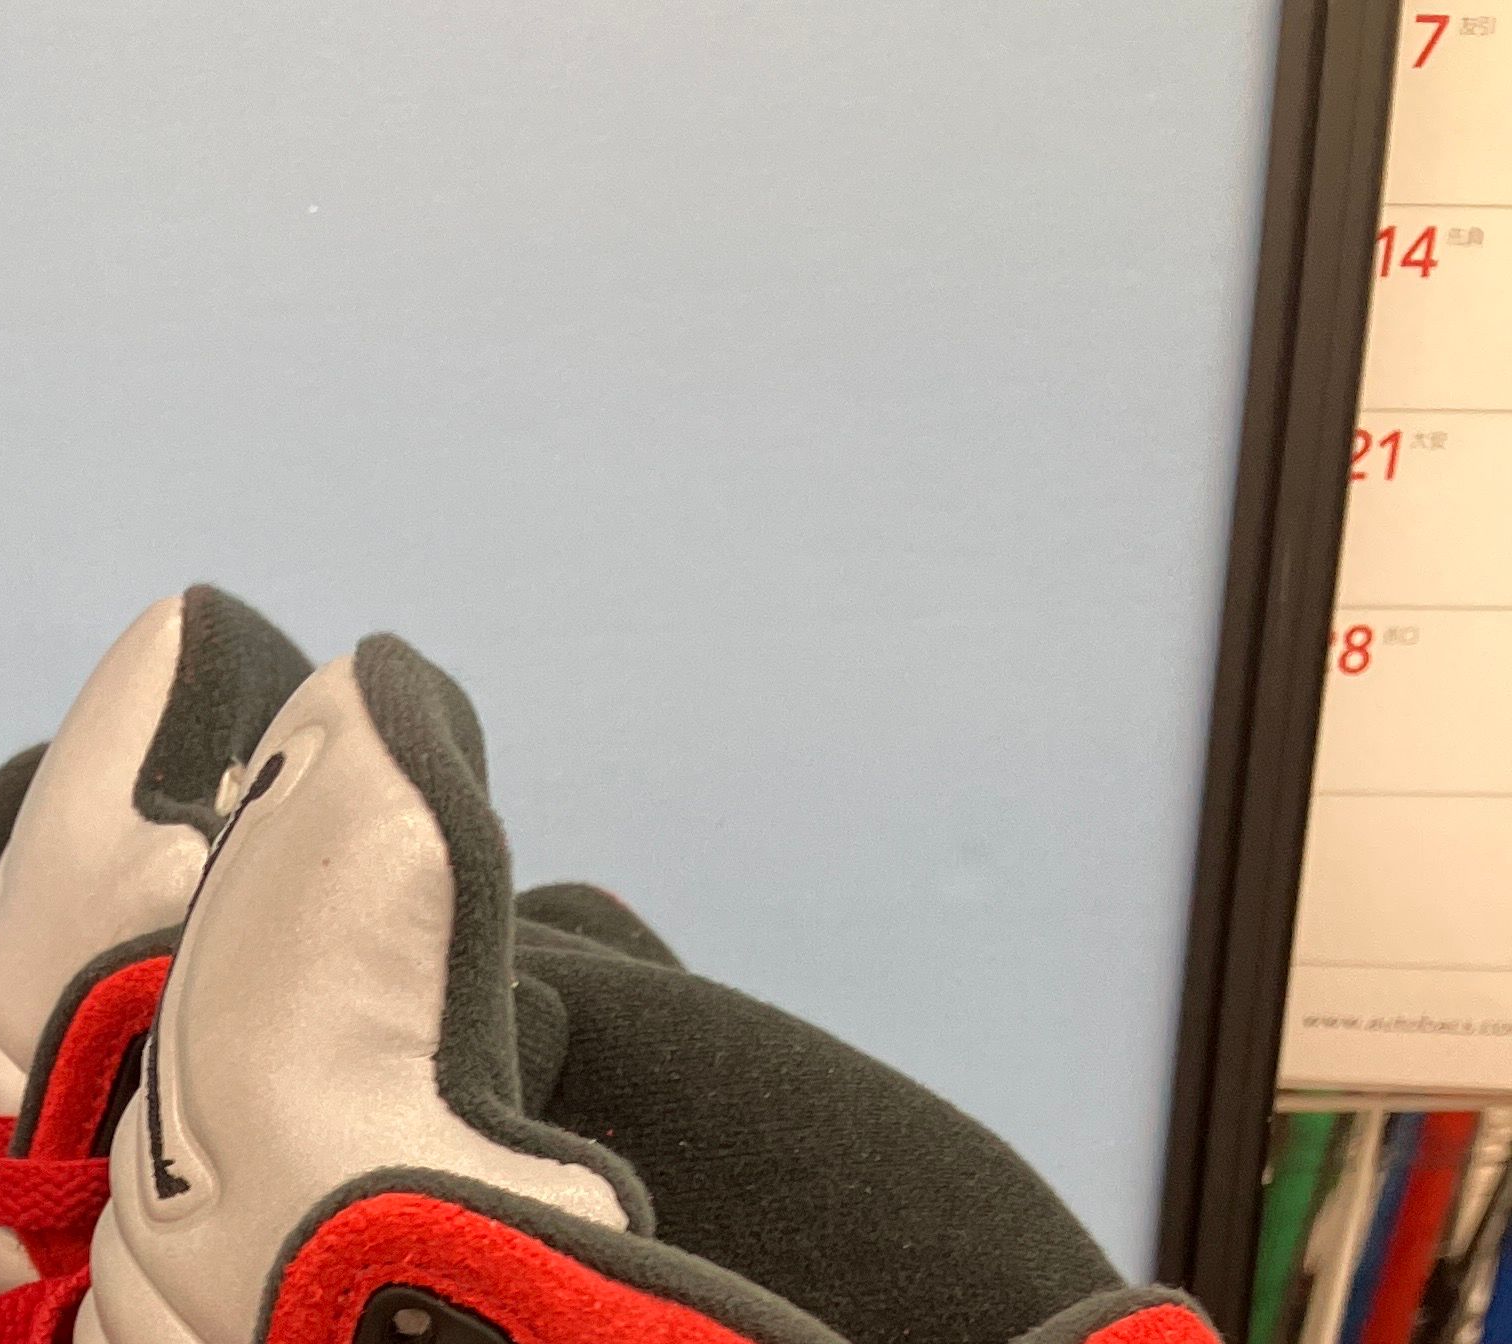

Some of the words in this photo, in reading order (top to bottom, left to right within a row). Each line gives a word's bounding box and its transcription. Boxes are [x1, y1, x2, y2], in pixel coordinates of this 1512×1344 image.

[1413, 14, 1451, 69] 7
[1376, 225, 1438, 279] 14
[1349, 428, 1402, 482] 21
[1329, 624, 1375, 676] 8
